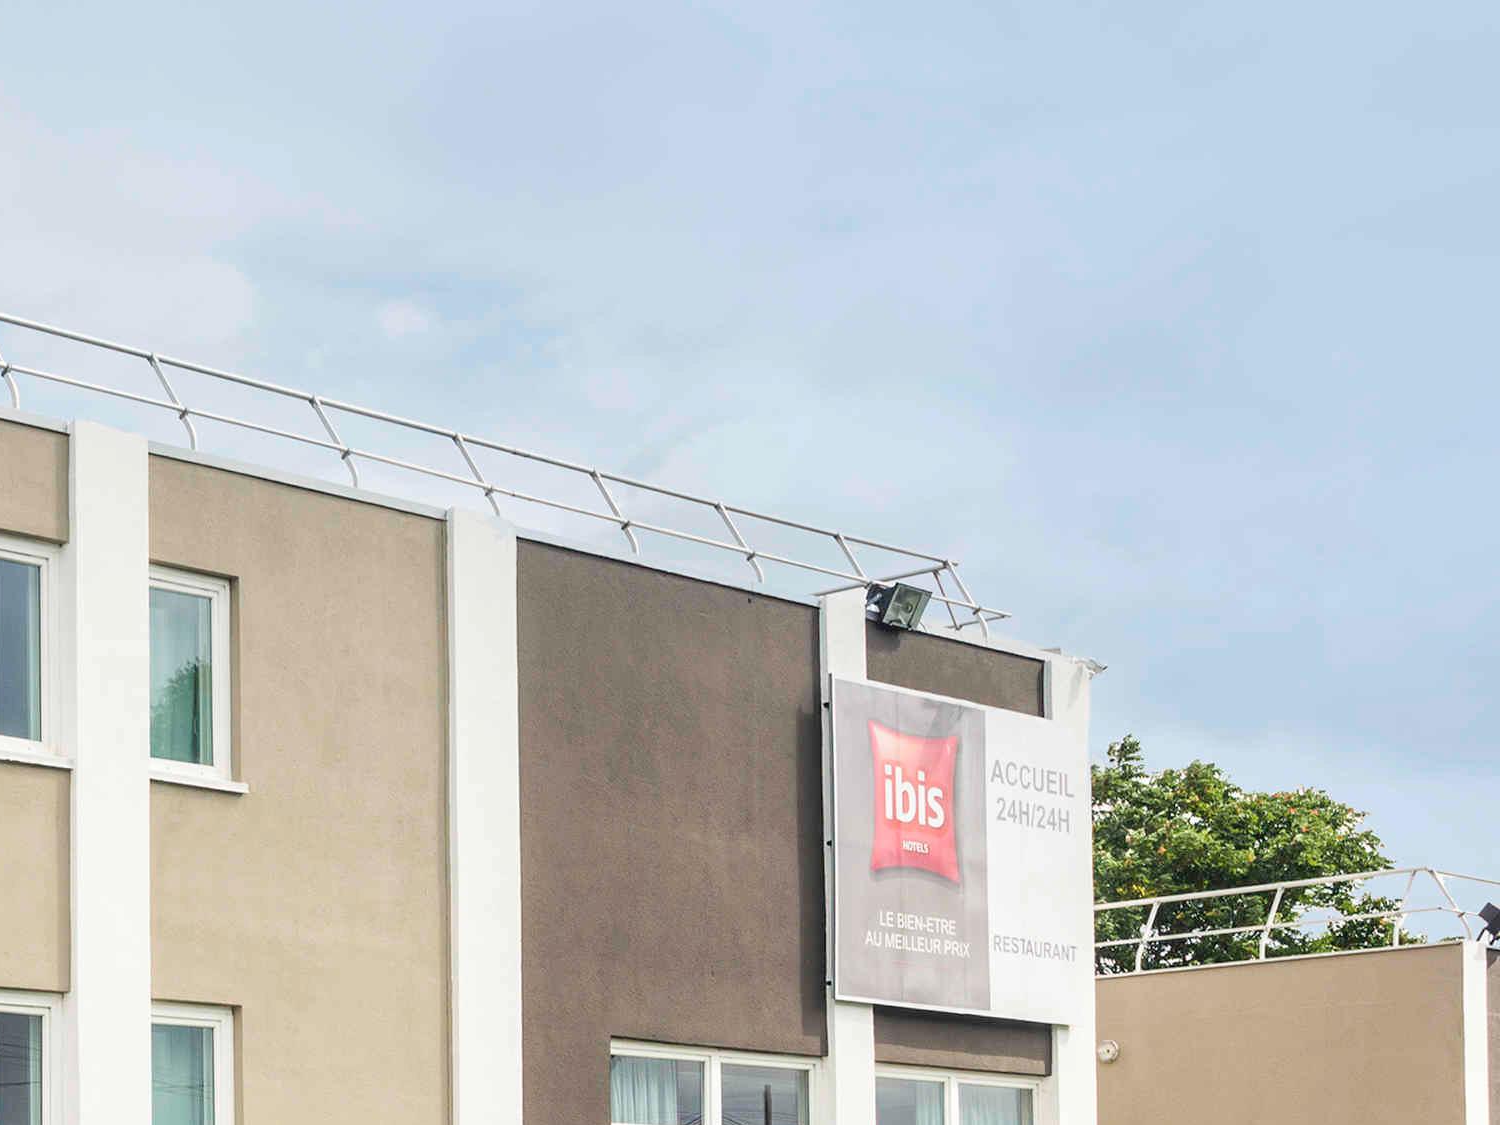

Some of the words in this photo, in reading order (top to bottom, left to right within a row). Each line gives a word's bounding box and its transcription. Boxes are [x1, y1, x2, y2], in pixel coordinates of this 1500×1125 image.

[990, 759, 1074, 798] ACCUEIL
[884, 763, 946, 829] ibis
[996, 797, 1071, 833] 24H/24H
[902, 839, 929, 854] HOTELS
[879, 911, 894, 927] LE
[897, 912, 957, 936] BIEN-ETRE
[865, 930, 882, 946] AU
[885, 932, 941, 954] MEILLEUR
[944, 940, 971, 958] PRIX
[993, 935, 1077, 963] RESTAURANT
